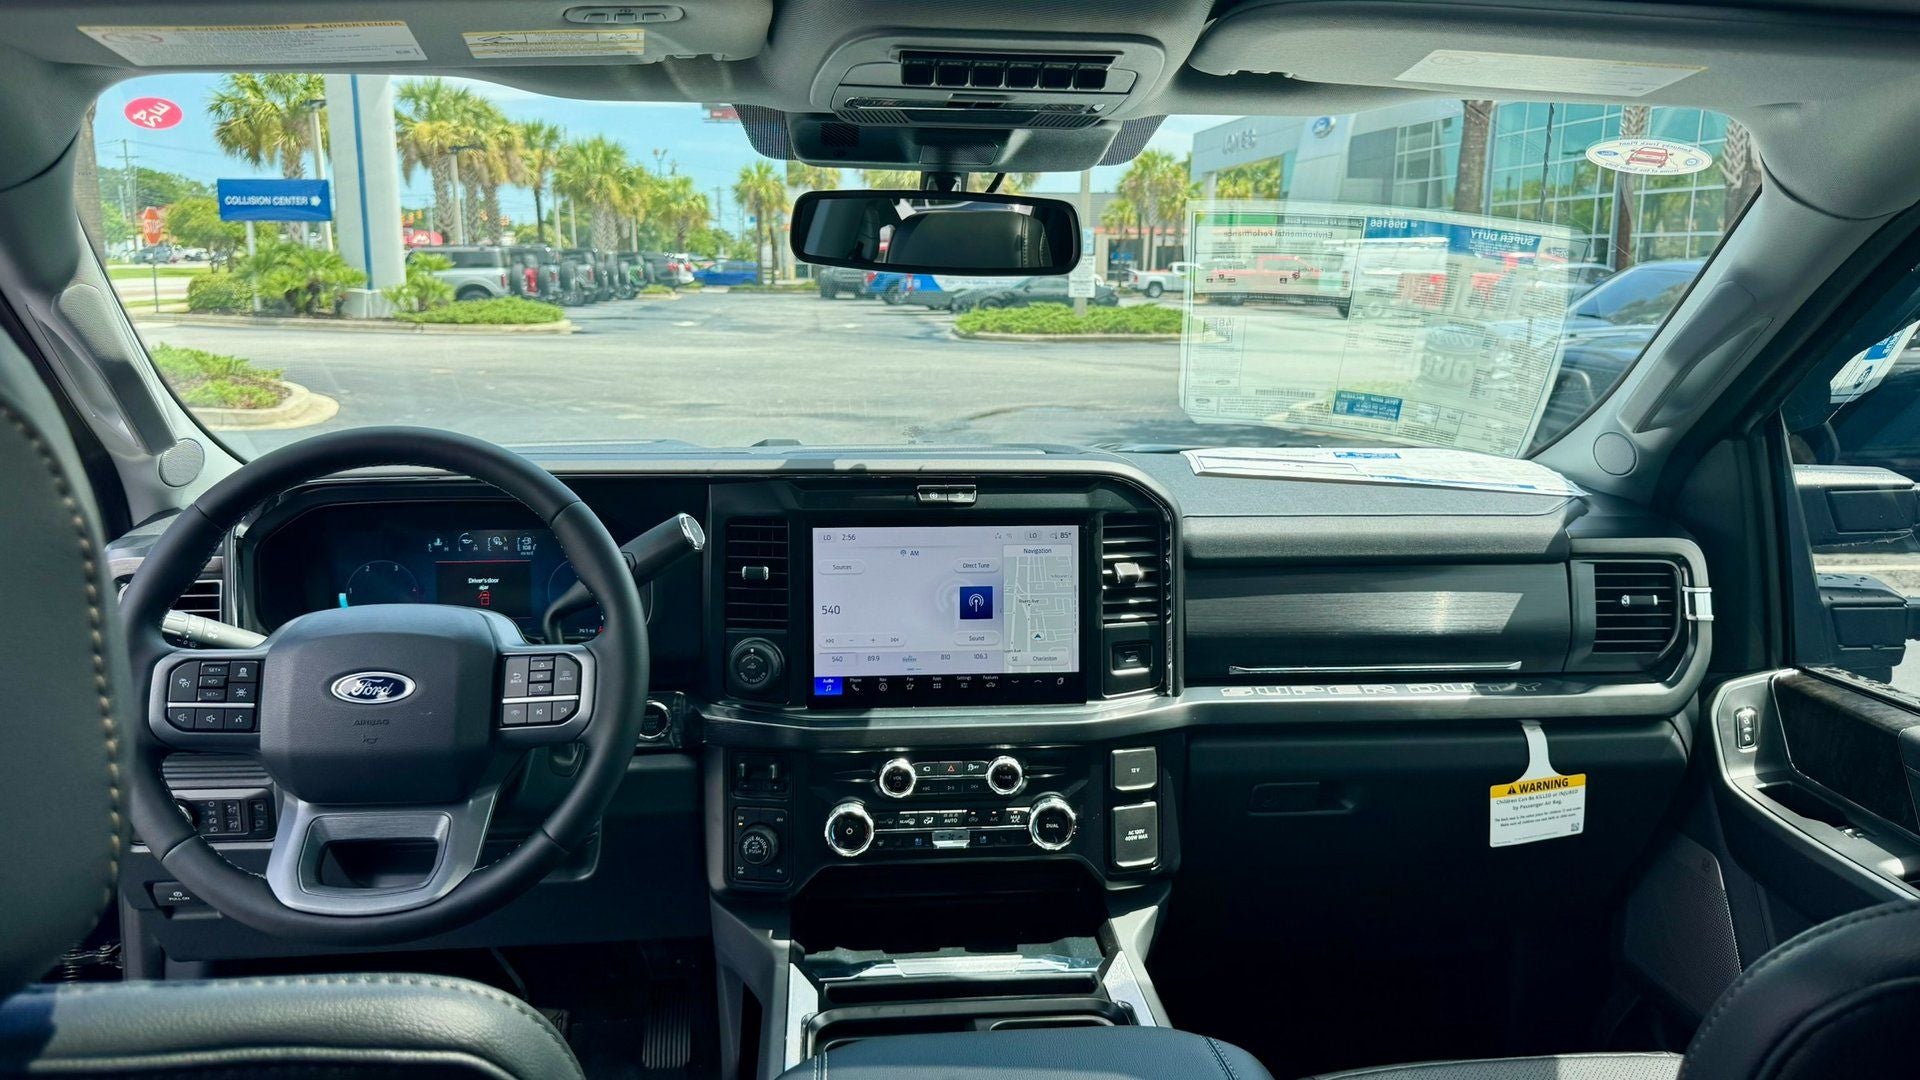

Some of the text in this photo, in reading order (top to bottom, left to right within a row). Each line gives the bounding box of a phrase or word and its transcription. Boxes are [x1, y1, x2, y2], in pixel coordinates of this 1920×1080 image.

[225, 195, 308, 206] COLLISION CENTER
[144, 219, 160, 232] STOP
[821, 605, 841, 615] 540
[350, 678, 394, 696] Ford
[1221, 682, 1543, 697] SUPER DUTY
[1518, 778, 1569, 794] WARNING
[1558, 789, 1579, 797] INJURED
[1520, 802, 1543, 810] Passenger
